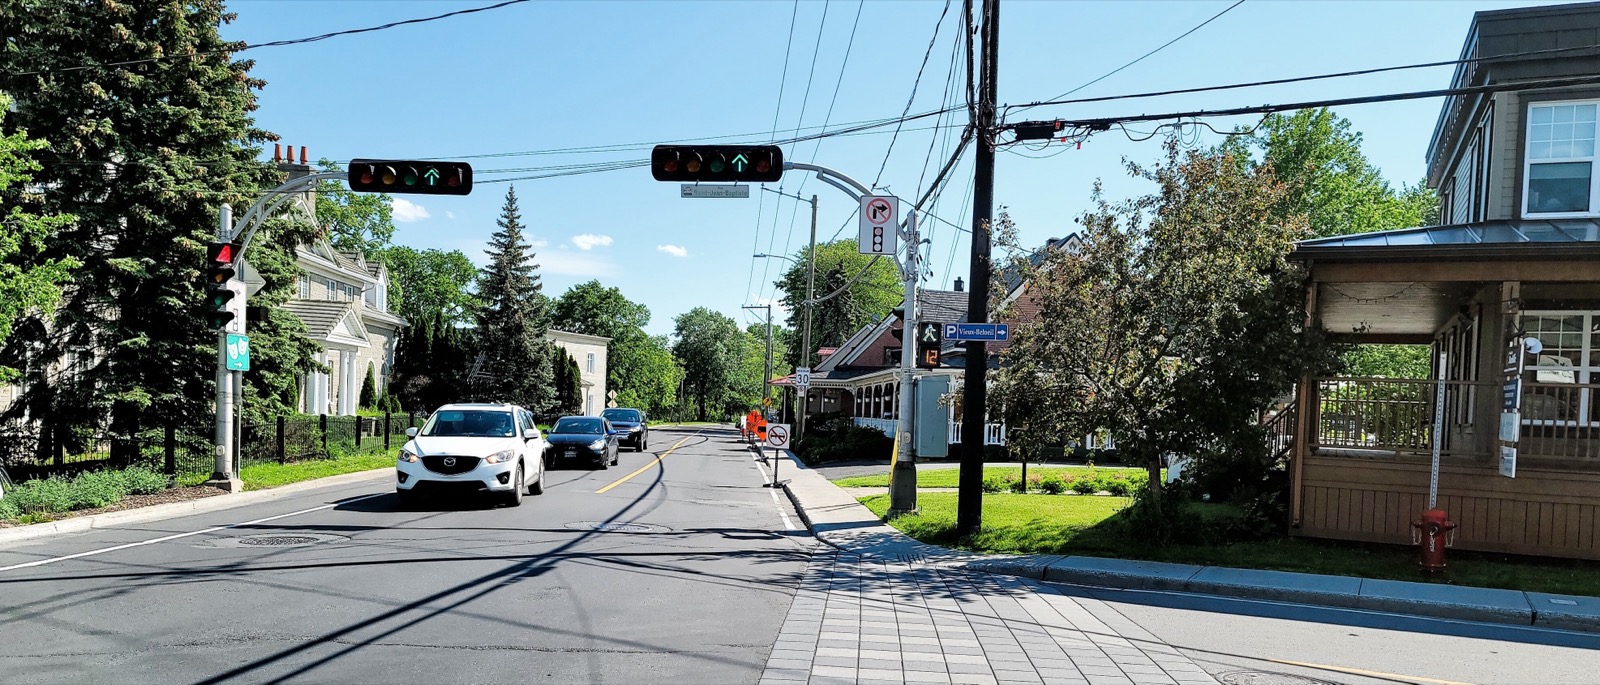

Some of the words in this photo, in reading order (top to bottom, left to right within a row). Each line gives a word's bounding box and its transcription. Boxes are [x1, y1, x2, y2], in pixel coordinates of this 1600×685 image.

[946, 325, 956, 337] P
[926, 349, 938, 365] 12
[797, 374, 809, 384] 30
